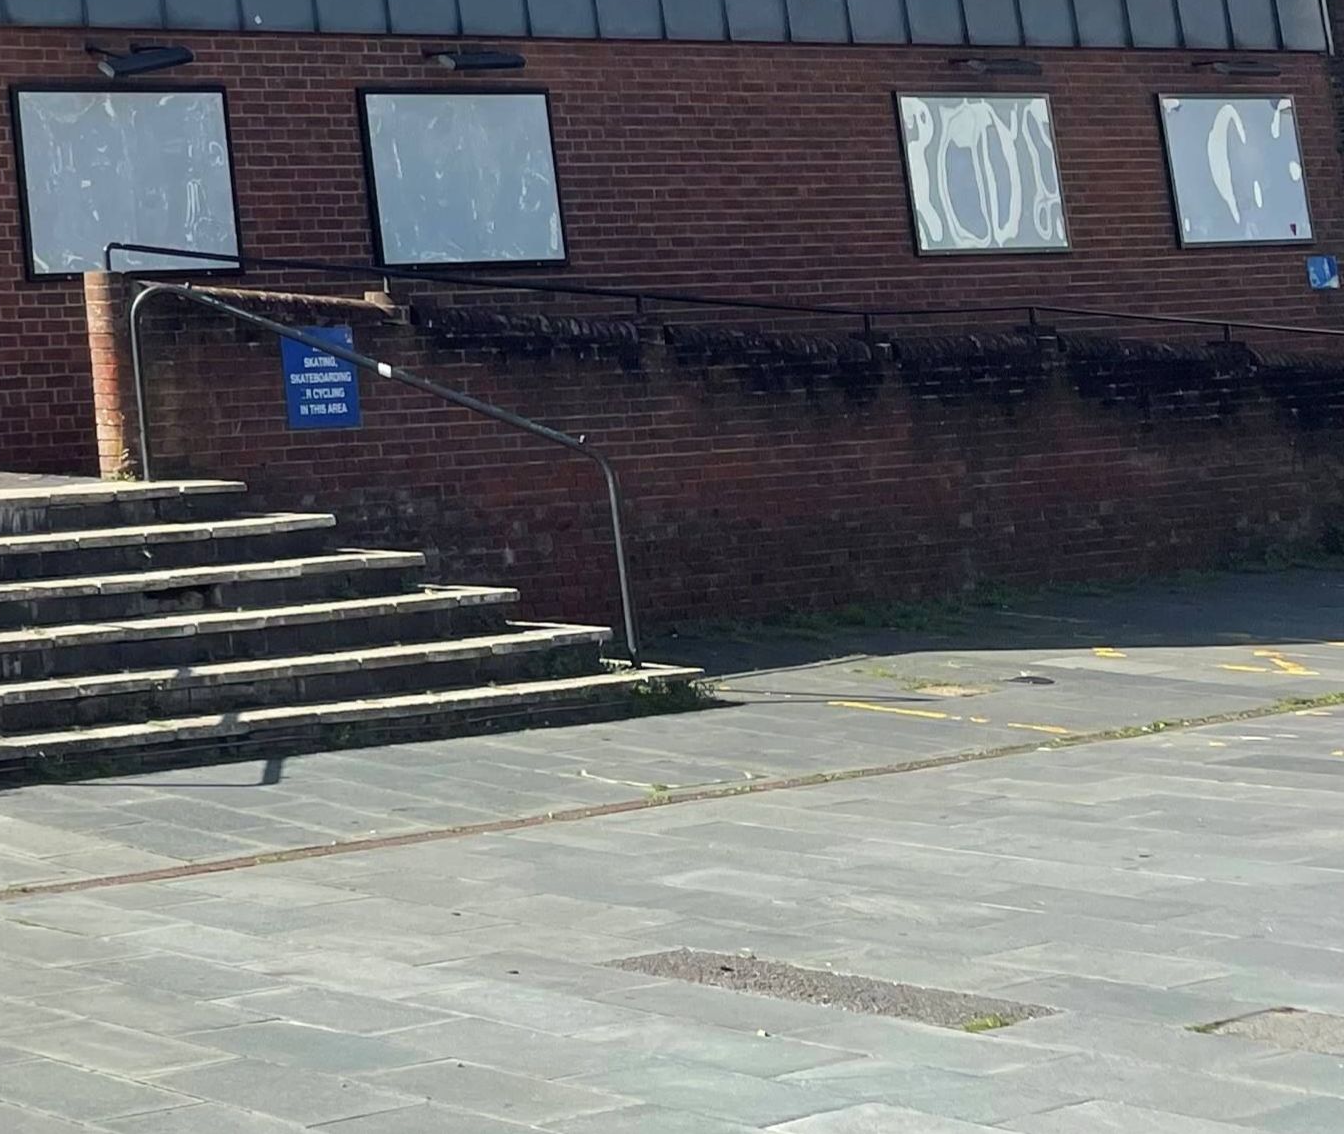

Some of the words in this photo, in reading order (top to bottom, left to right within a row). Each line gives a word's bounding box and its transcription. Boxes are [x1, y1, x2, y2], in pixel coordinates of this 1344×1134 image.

[290, 372, 352, 384] SKATEBOARDING
[312, 387, 345, 399] CYCLING
[300, 404, 309, 415] IN
[309, 404, 327, 415] THIS
[327, 402, 348, 414] AREA
